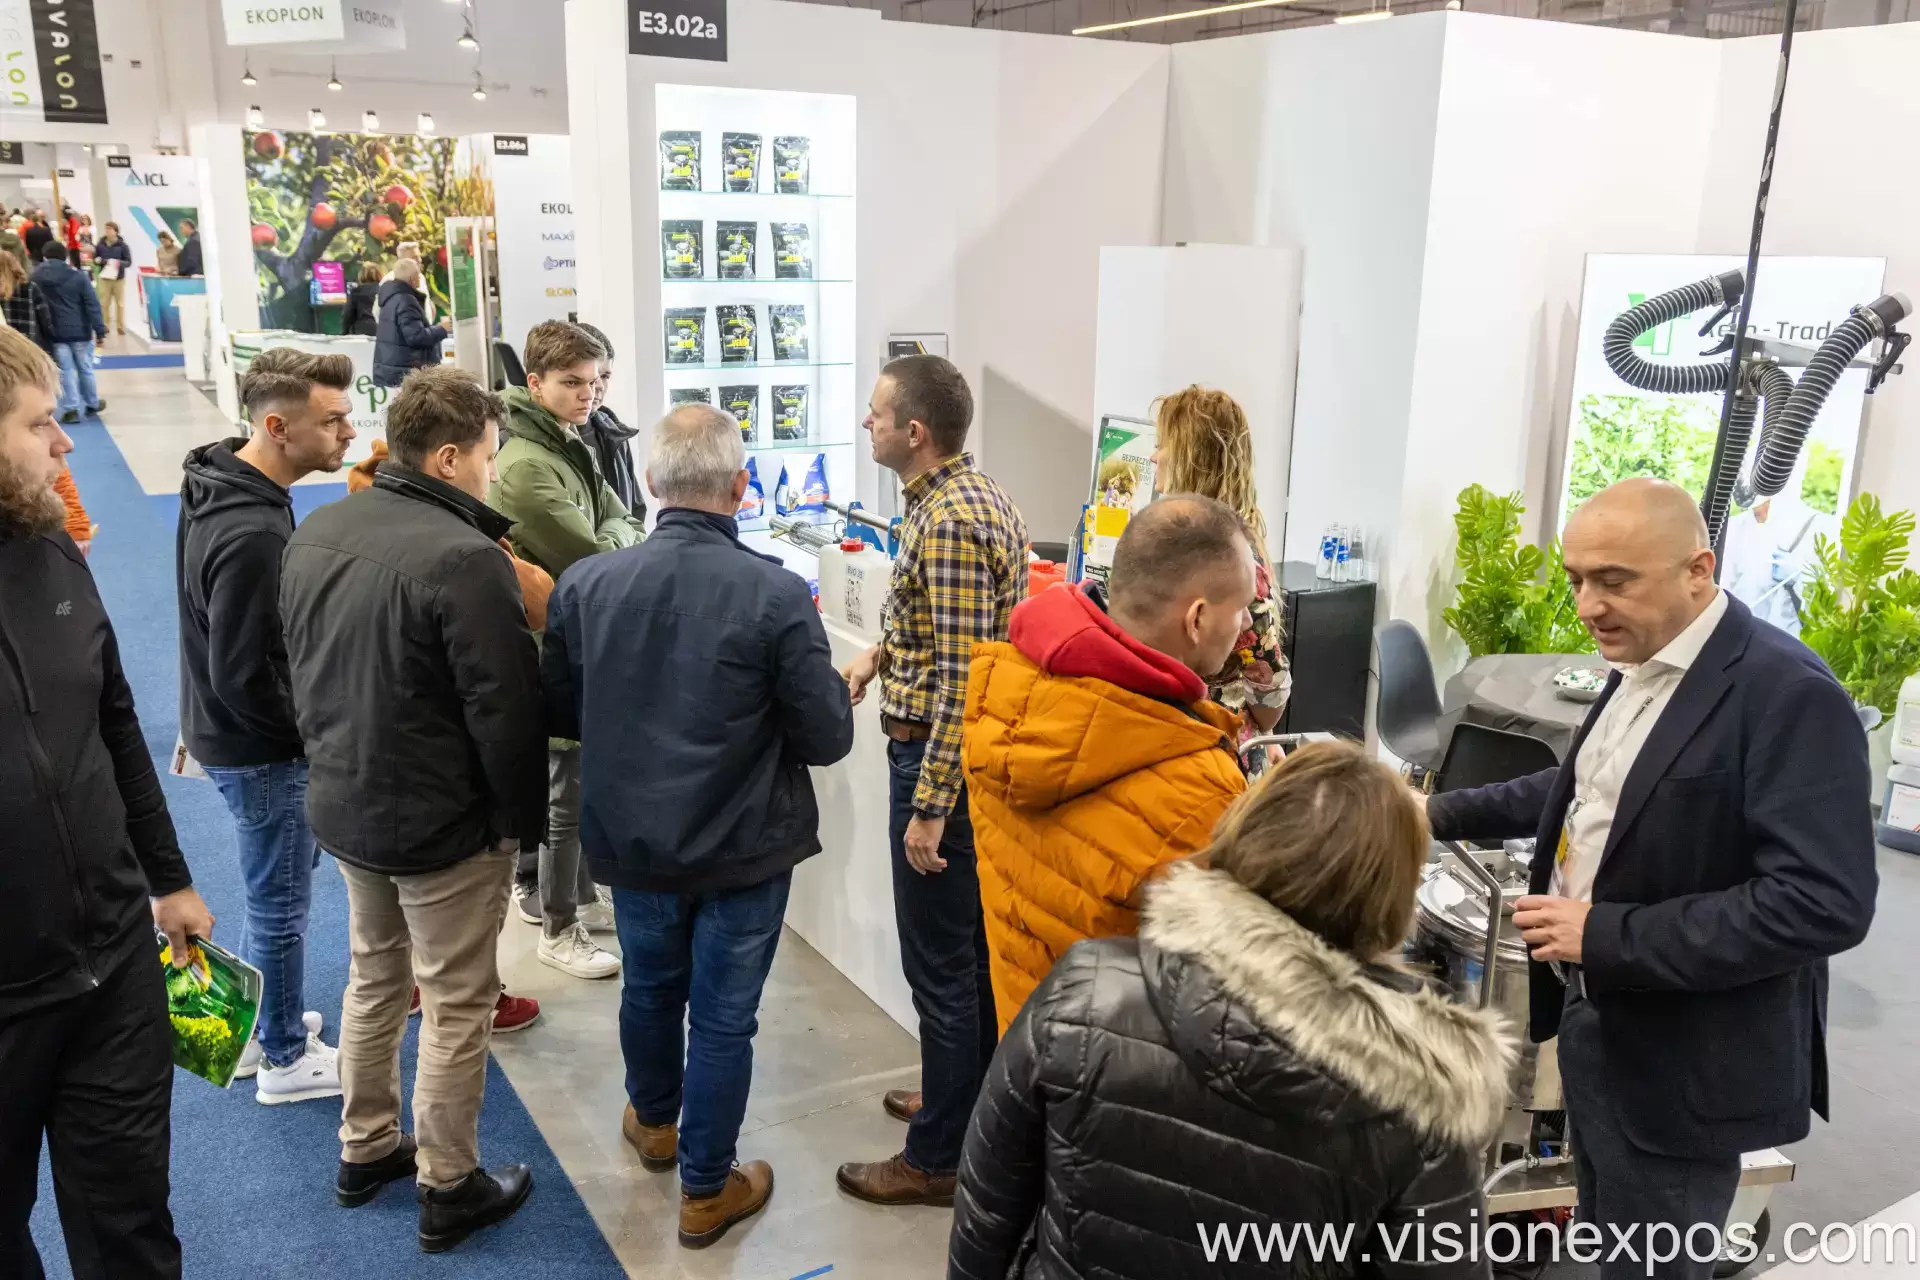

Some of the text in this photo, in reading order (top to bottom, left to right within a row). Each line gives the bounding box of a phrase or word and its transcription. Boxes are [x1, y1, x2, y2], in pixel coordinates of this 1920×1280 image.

[245, 6, 324, 24] EKOPLON
[639, 10, 718, 39] E3.02a
[144, 173, 169, 187] ICL
[1776, 320, 1832, 341] Trad
[356, 375, 388, 413] ep
